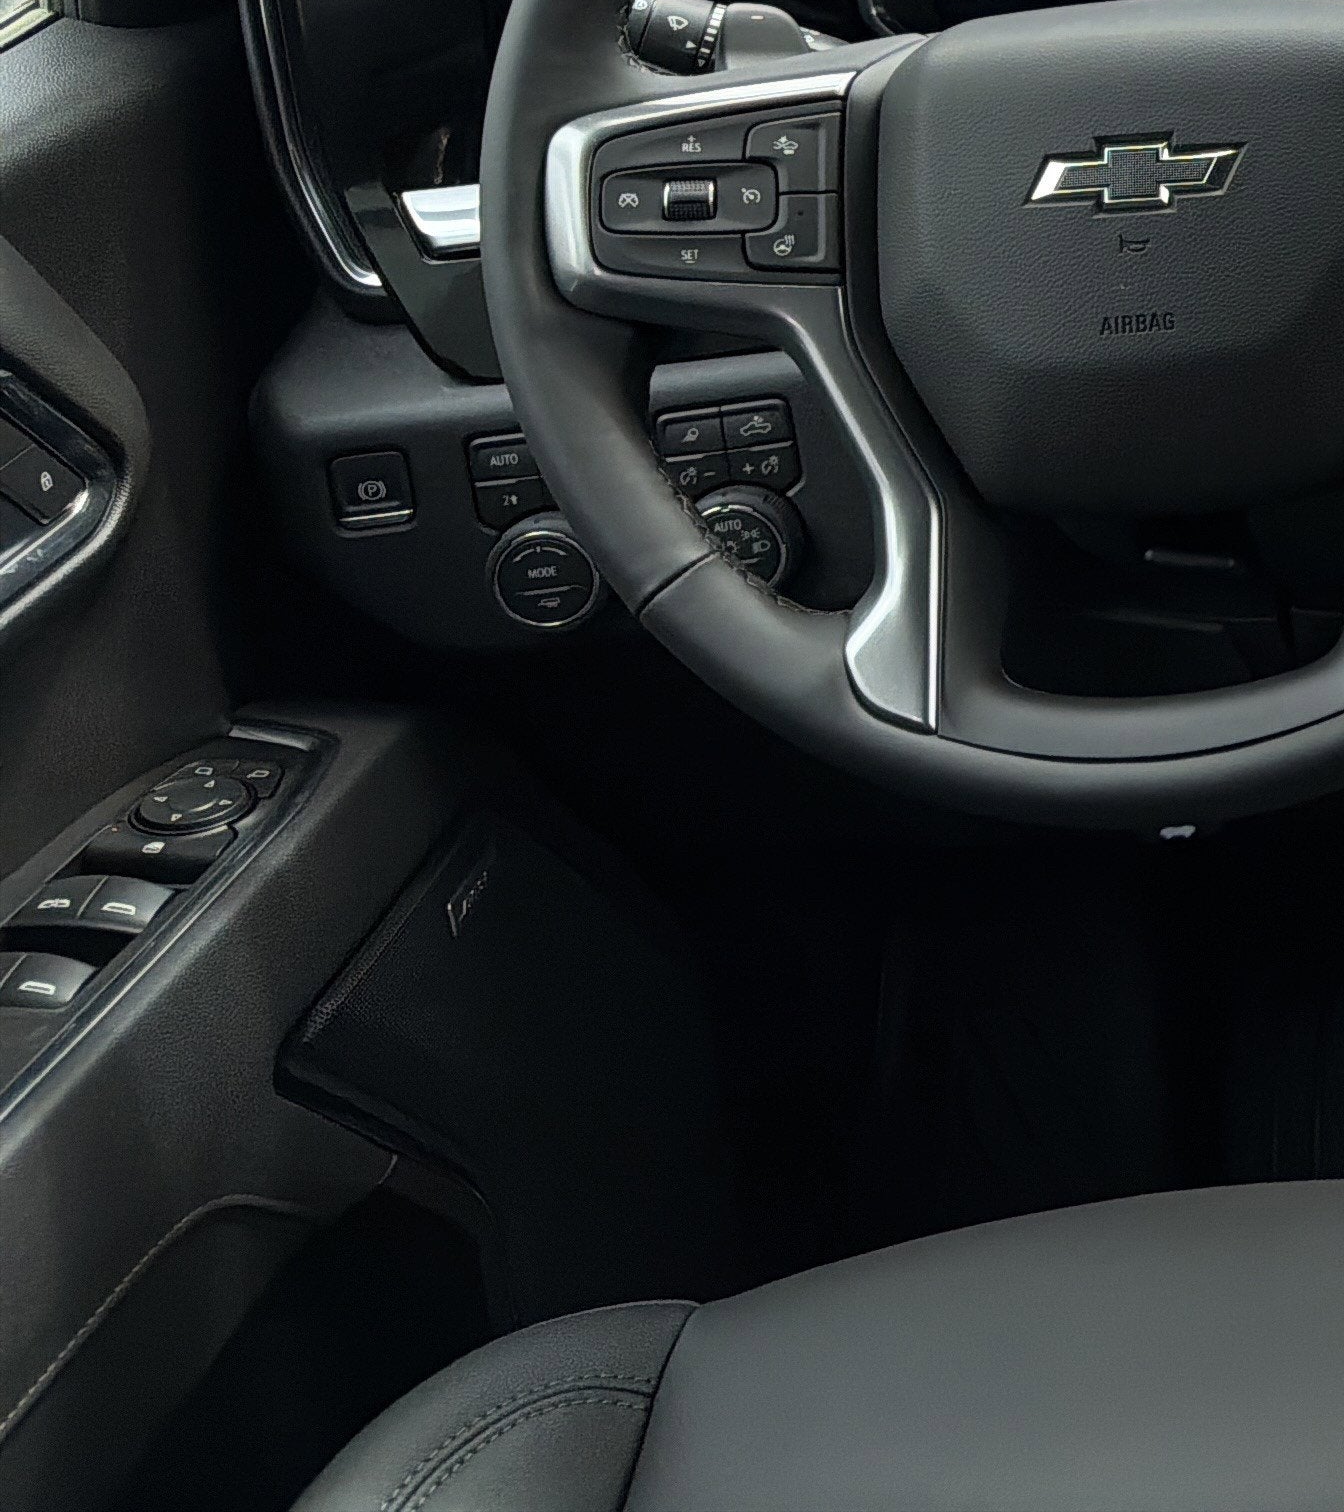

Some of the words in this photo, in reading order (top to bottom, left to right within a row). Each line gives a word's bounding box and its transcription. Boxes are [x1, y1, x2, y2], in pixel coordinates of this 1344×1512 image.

[682, 142, 702, 153] RES
[681, 249, 698, 260] SET
[1100, 311, 1176, 336] AIRBAG
[490, 453, 519, 468] AUTO
[713, 518, 742, 533] AUTO
[527, 565, 558, 579] MODE
